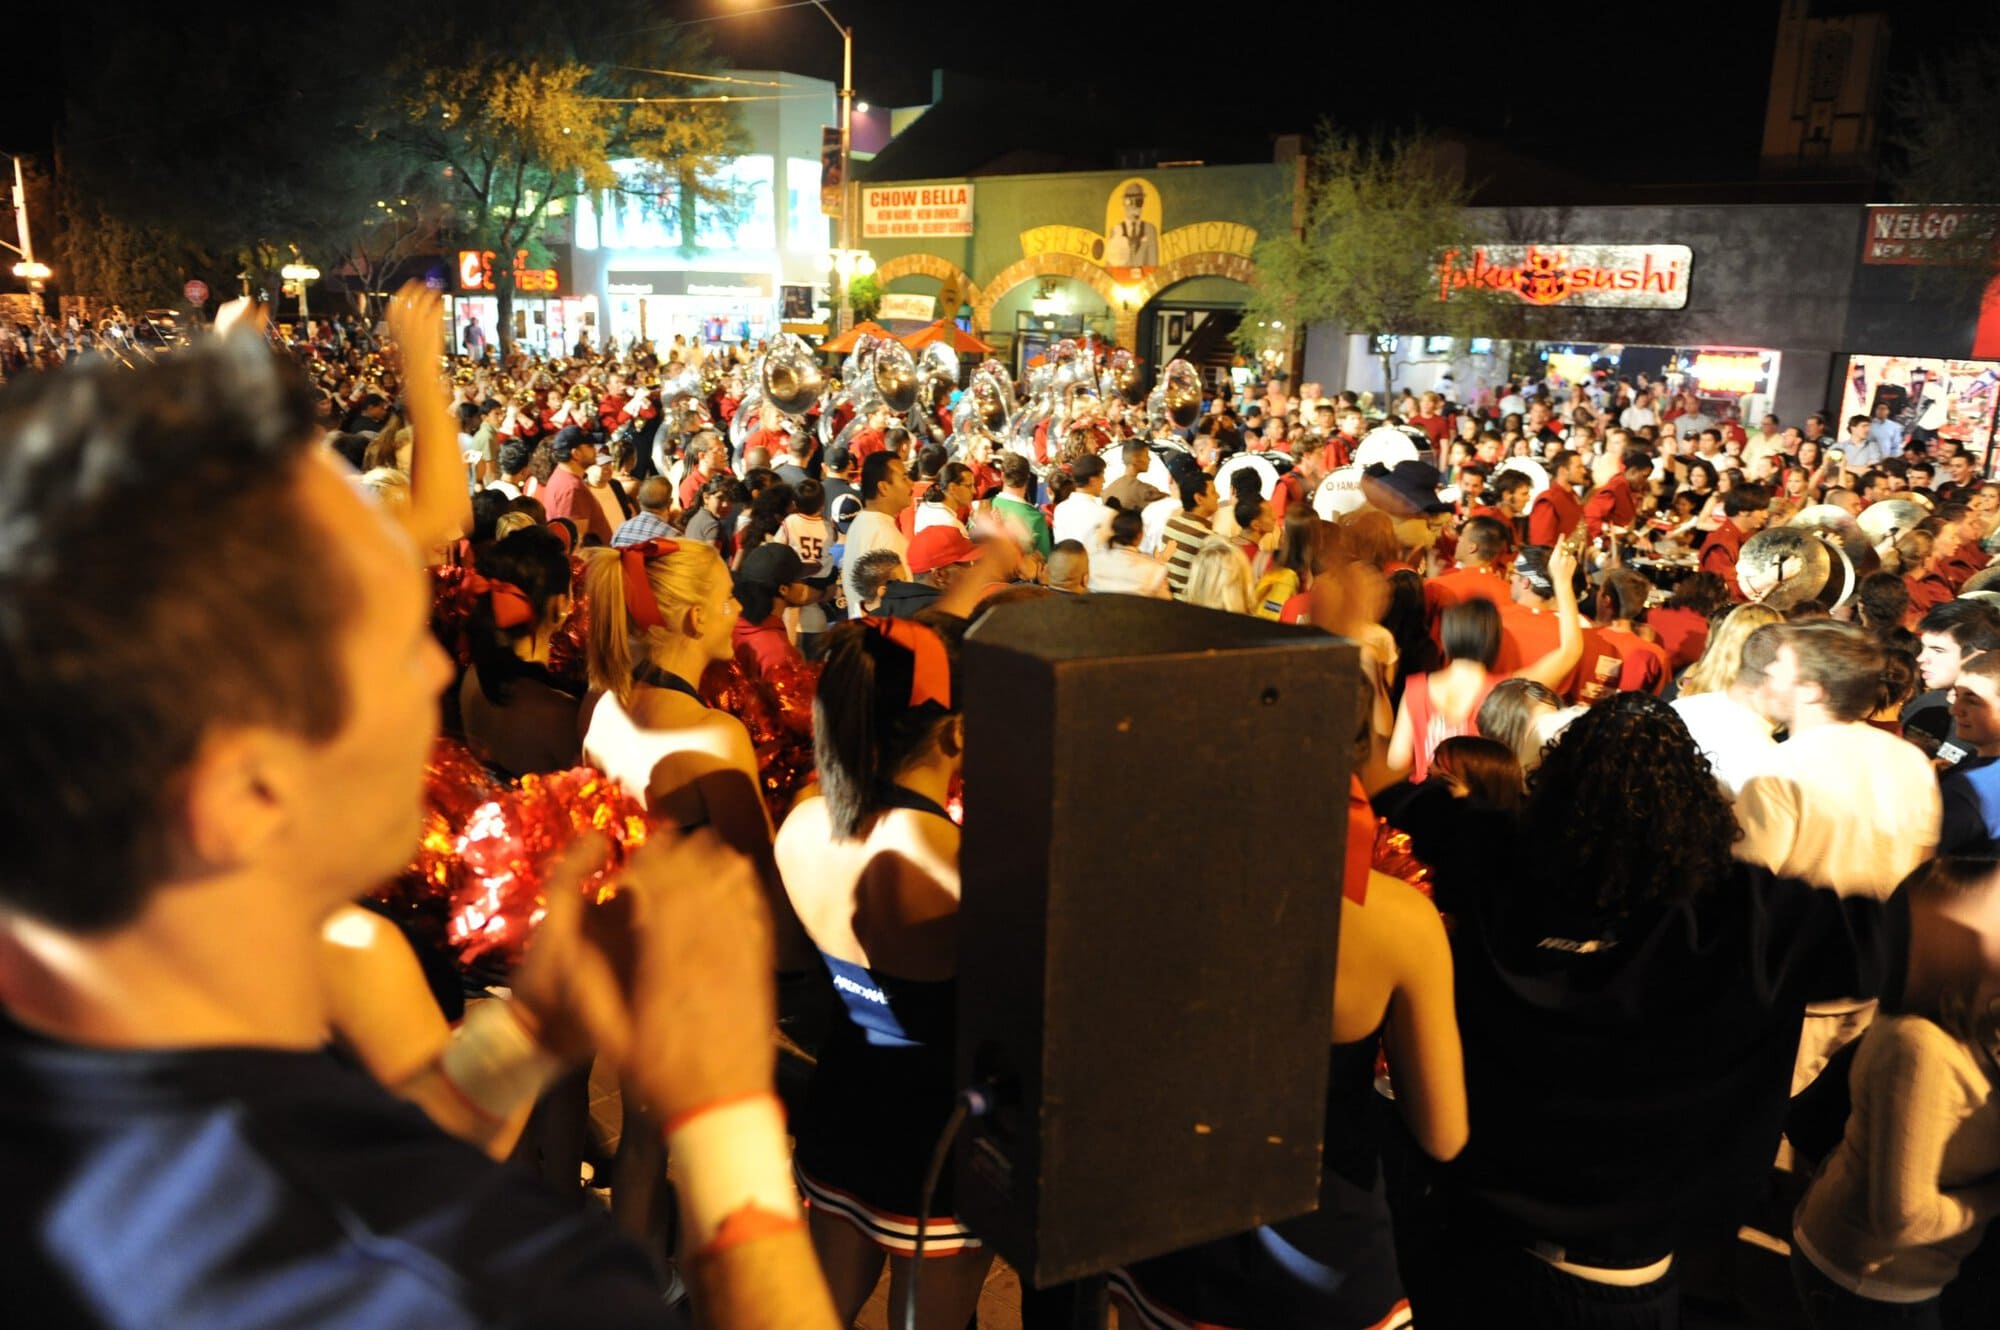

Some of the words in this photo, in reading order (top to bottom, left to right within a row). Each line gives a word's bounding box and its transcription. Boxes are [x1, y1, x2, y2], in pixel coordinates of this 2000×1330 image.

[870, 191, 917, 208] CHOW
[922, 188, 967, 206] BELLA
[1874, 212, 1996, 241] WELCO
[1571, 254, 1679, 294] sushi
[800, 536, 822, 560] 55
